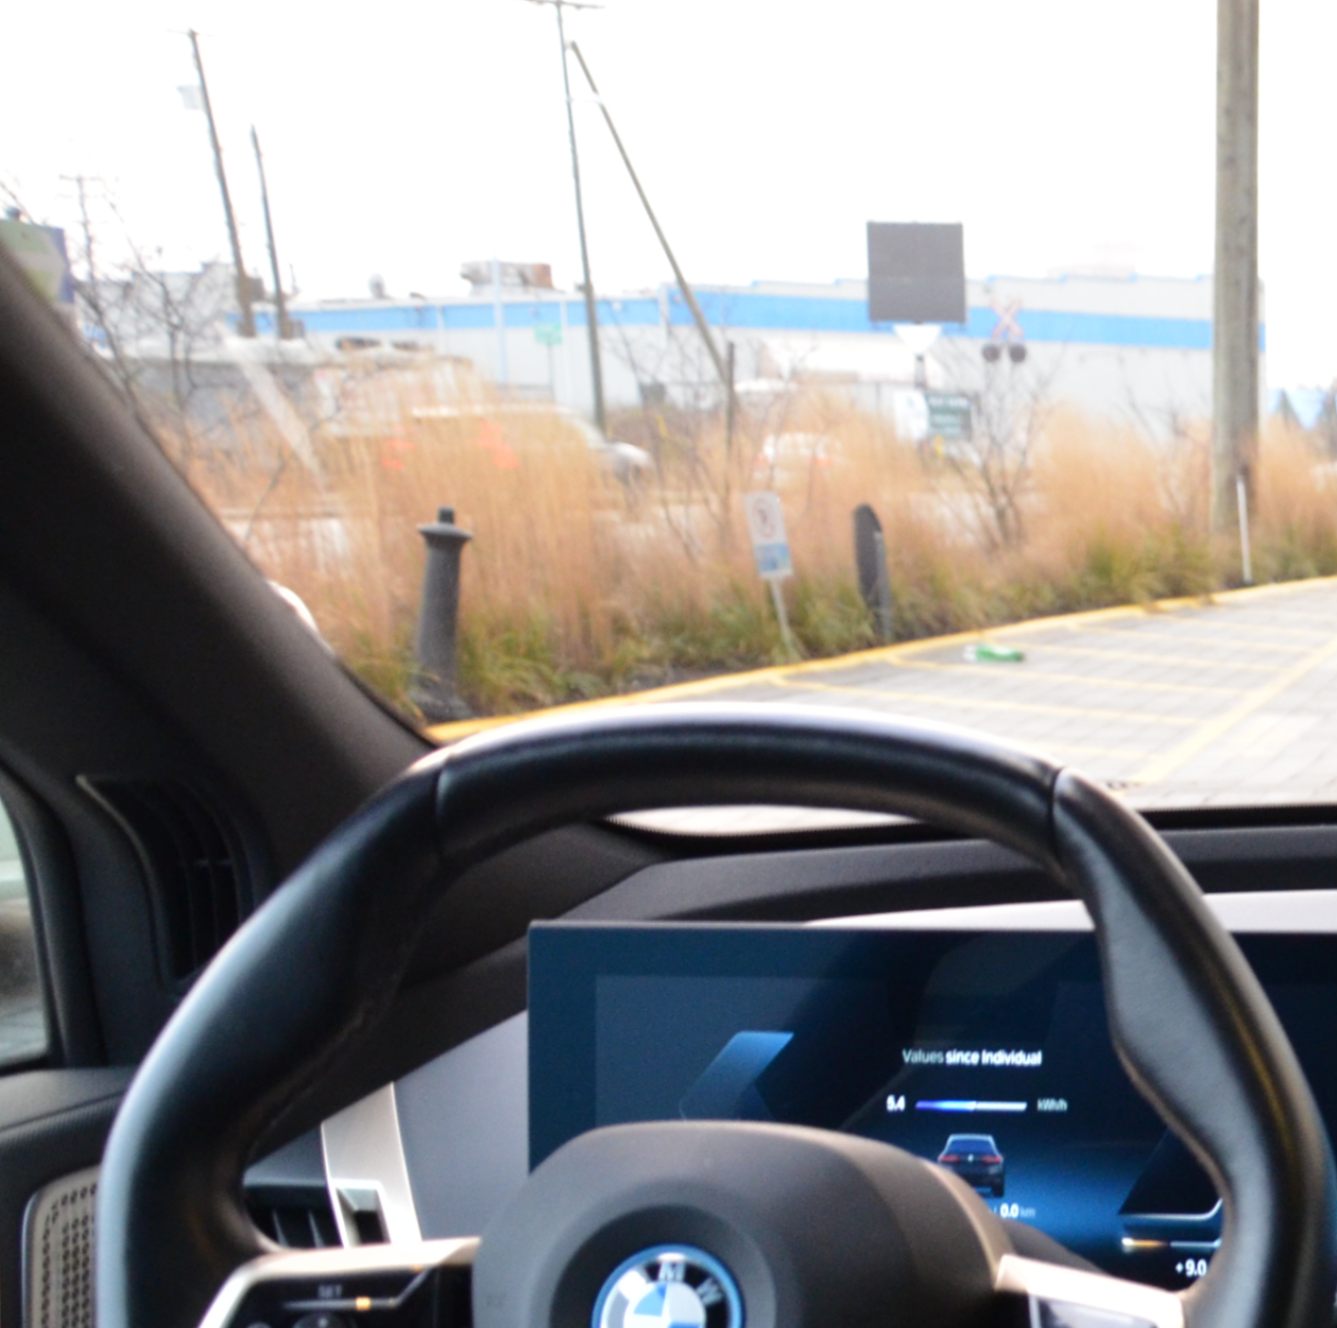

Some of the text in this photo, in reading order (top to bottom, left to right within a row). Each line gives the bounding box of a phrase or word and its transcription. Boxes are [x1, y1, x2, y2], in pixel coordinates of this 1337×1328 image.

[902, 1050, 1042, 1066] Values since Individual
[1000, 1203, 1036, 1218] 0.0 km
